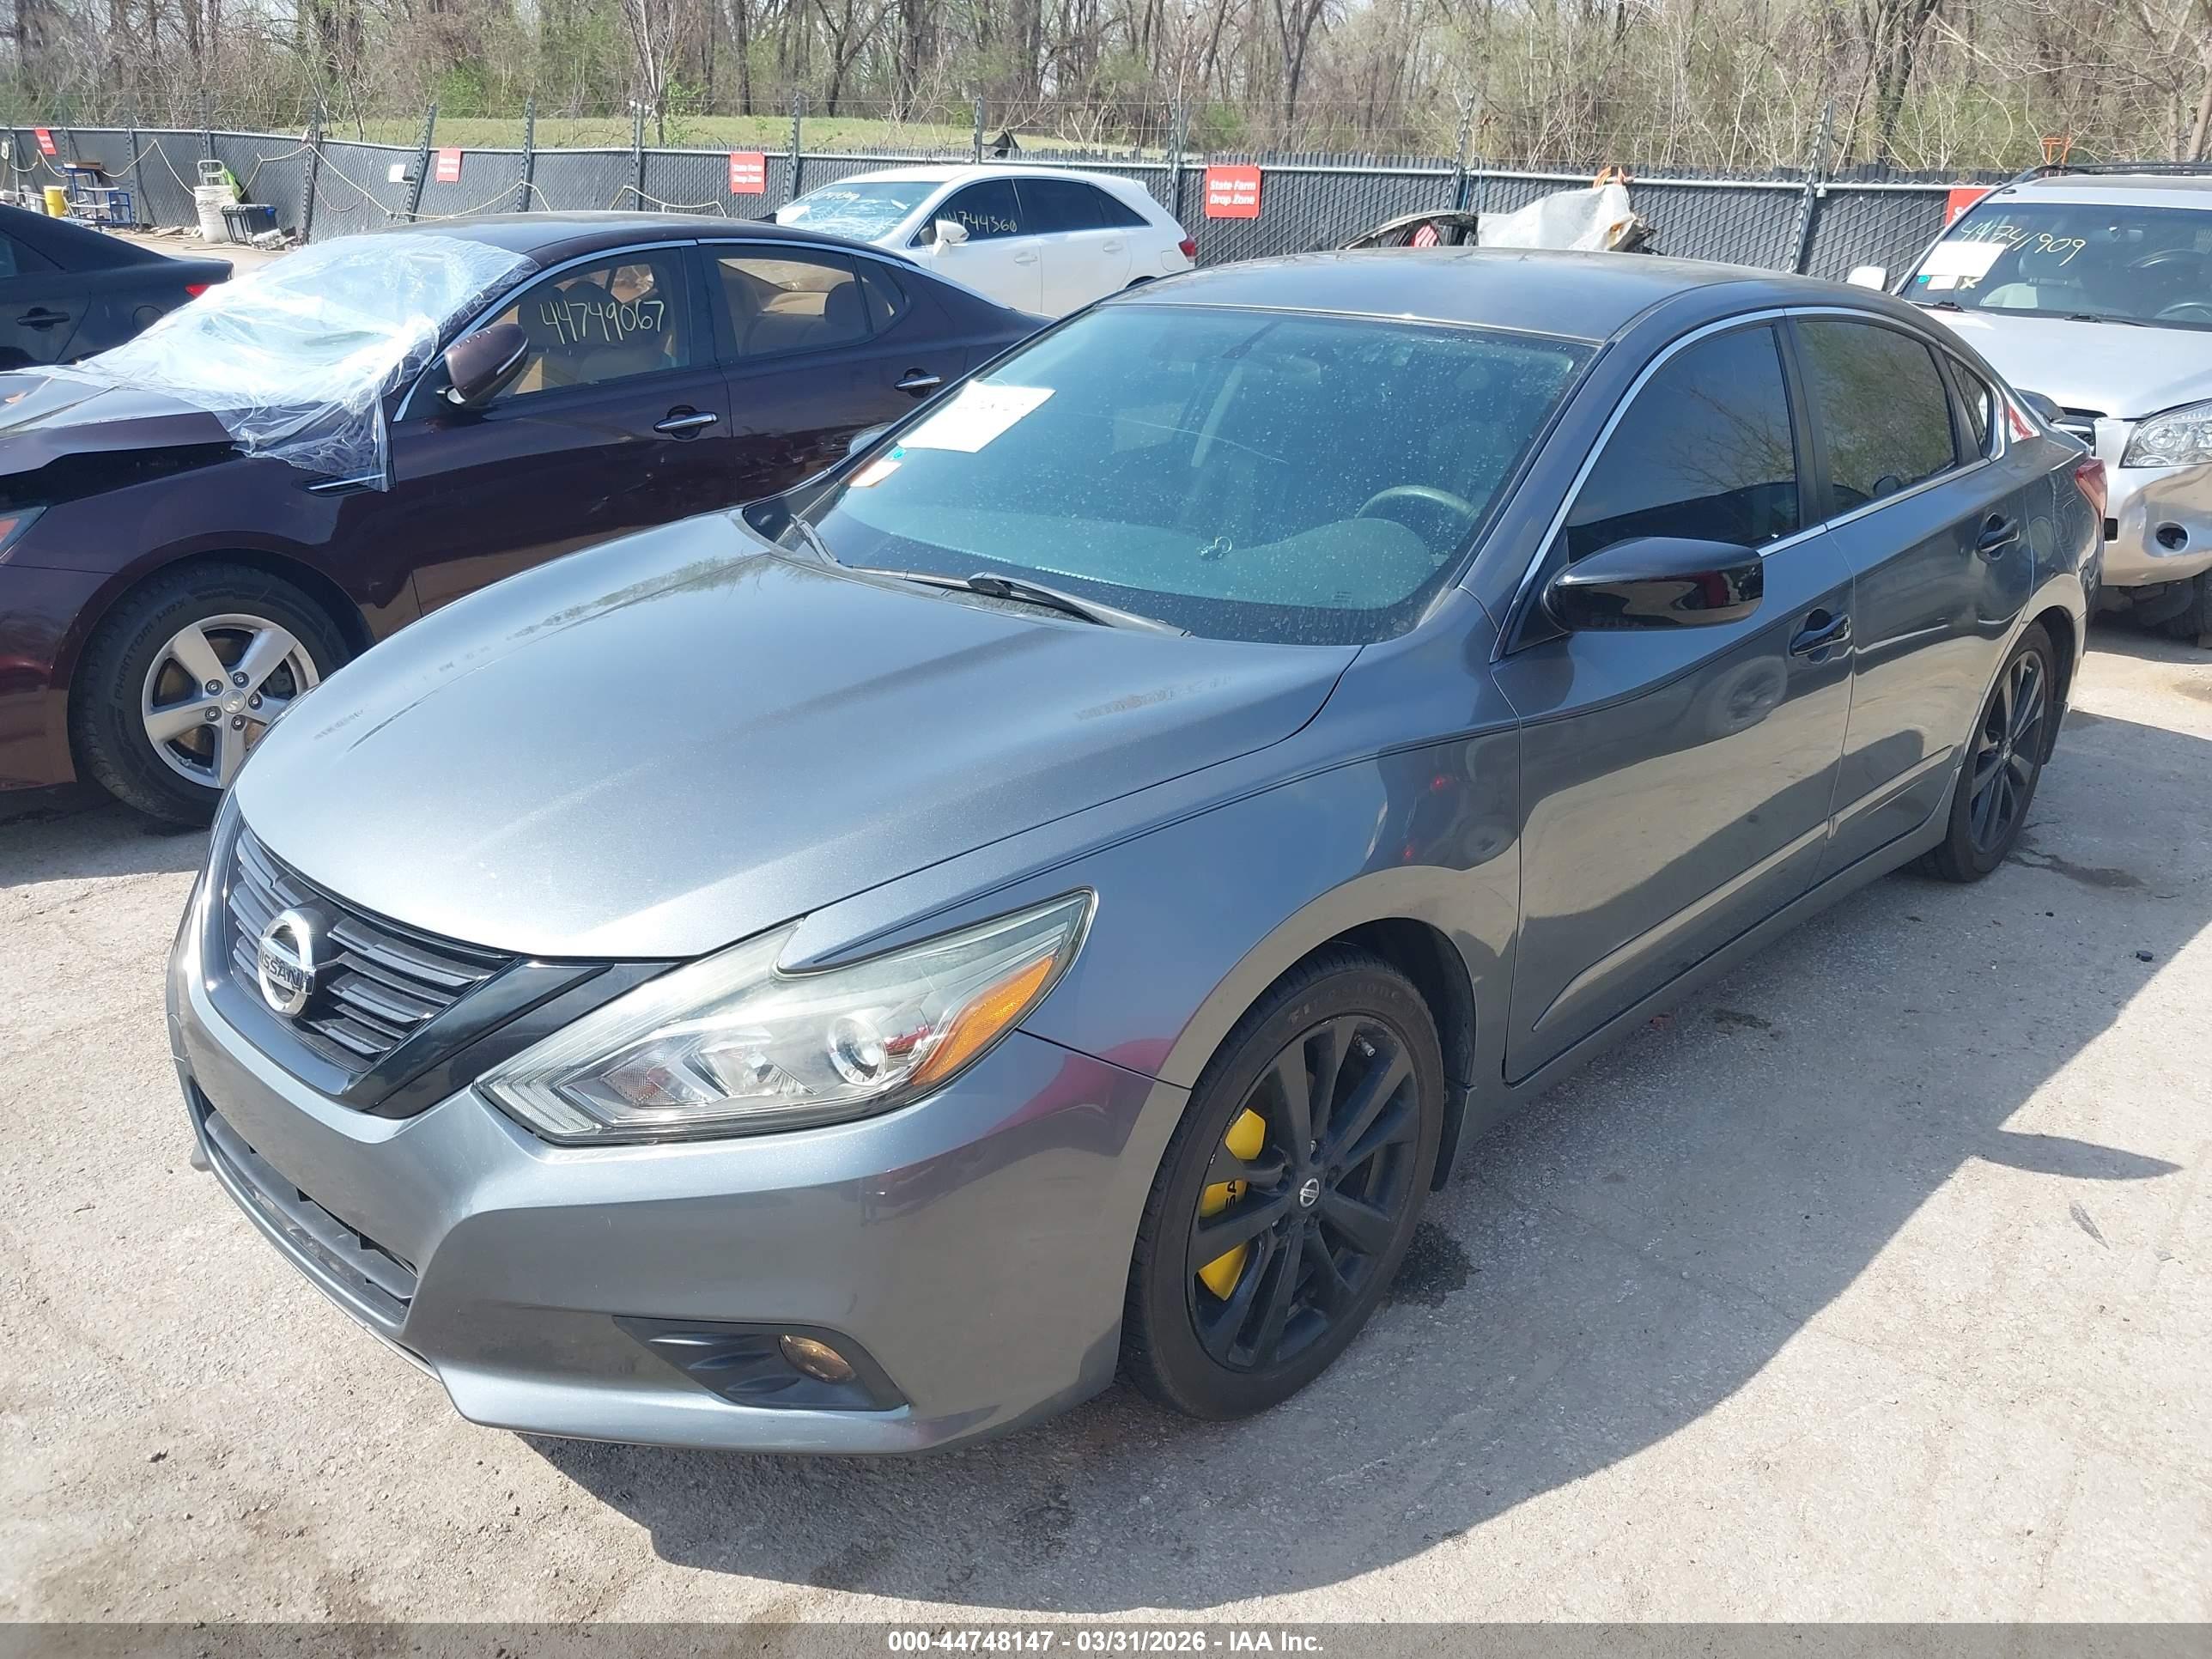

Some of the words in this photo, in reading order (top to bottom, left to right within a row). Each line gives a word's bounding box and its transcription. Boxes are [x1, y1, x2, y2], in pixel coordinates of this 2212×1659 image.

[1209, 179, 1231, 191] State
[1233, 179, 1257, 191] Farm
[1209, 192, 1231, 206] Drop
[1232, 193, 1256, 205] Zone
[539, 299, 665, 345] 44749067
